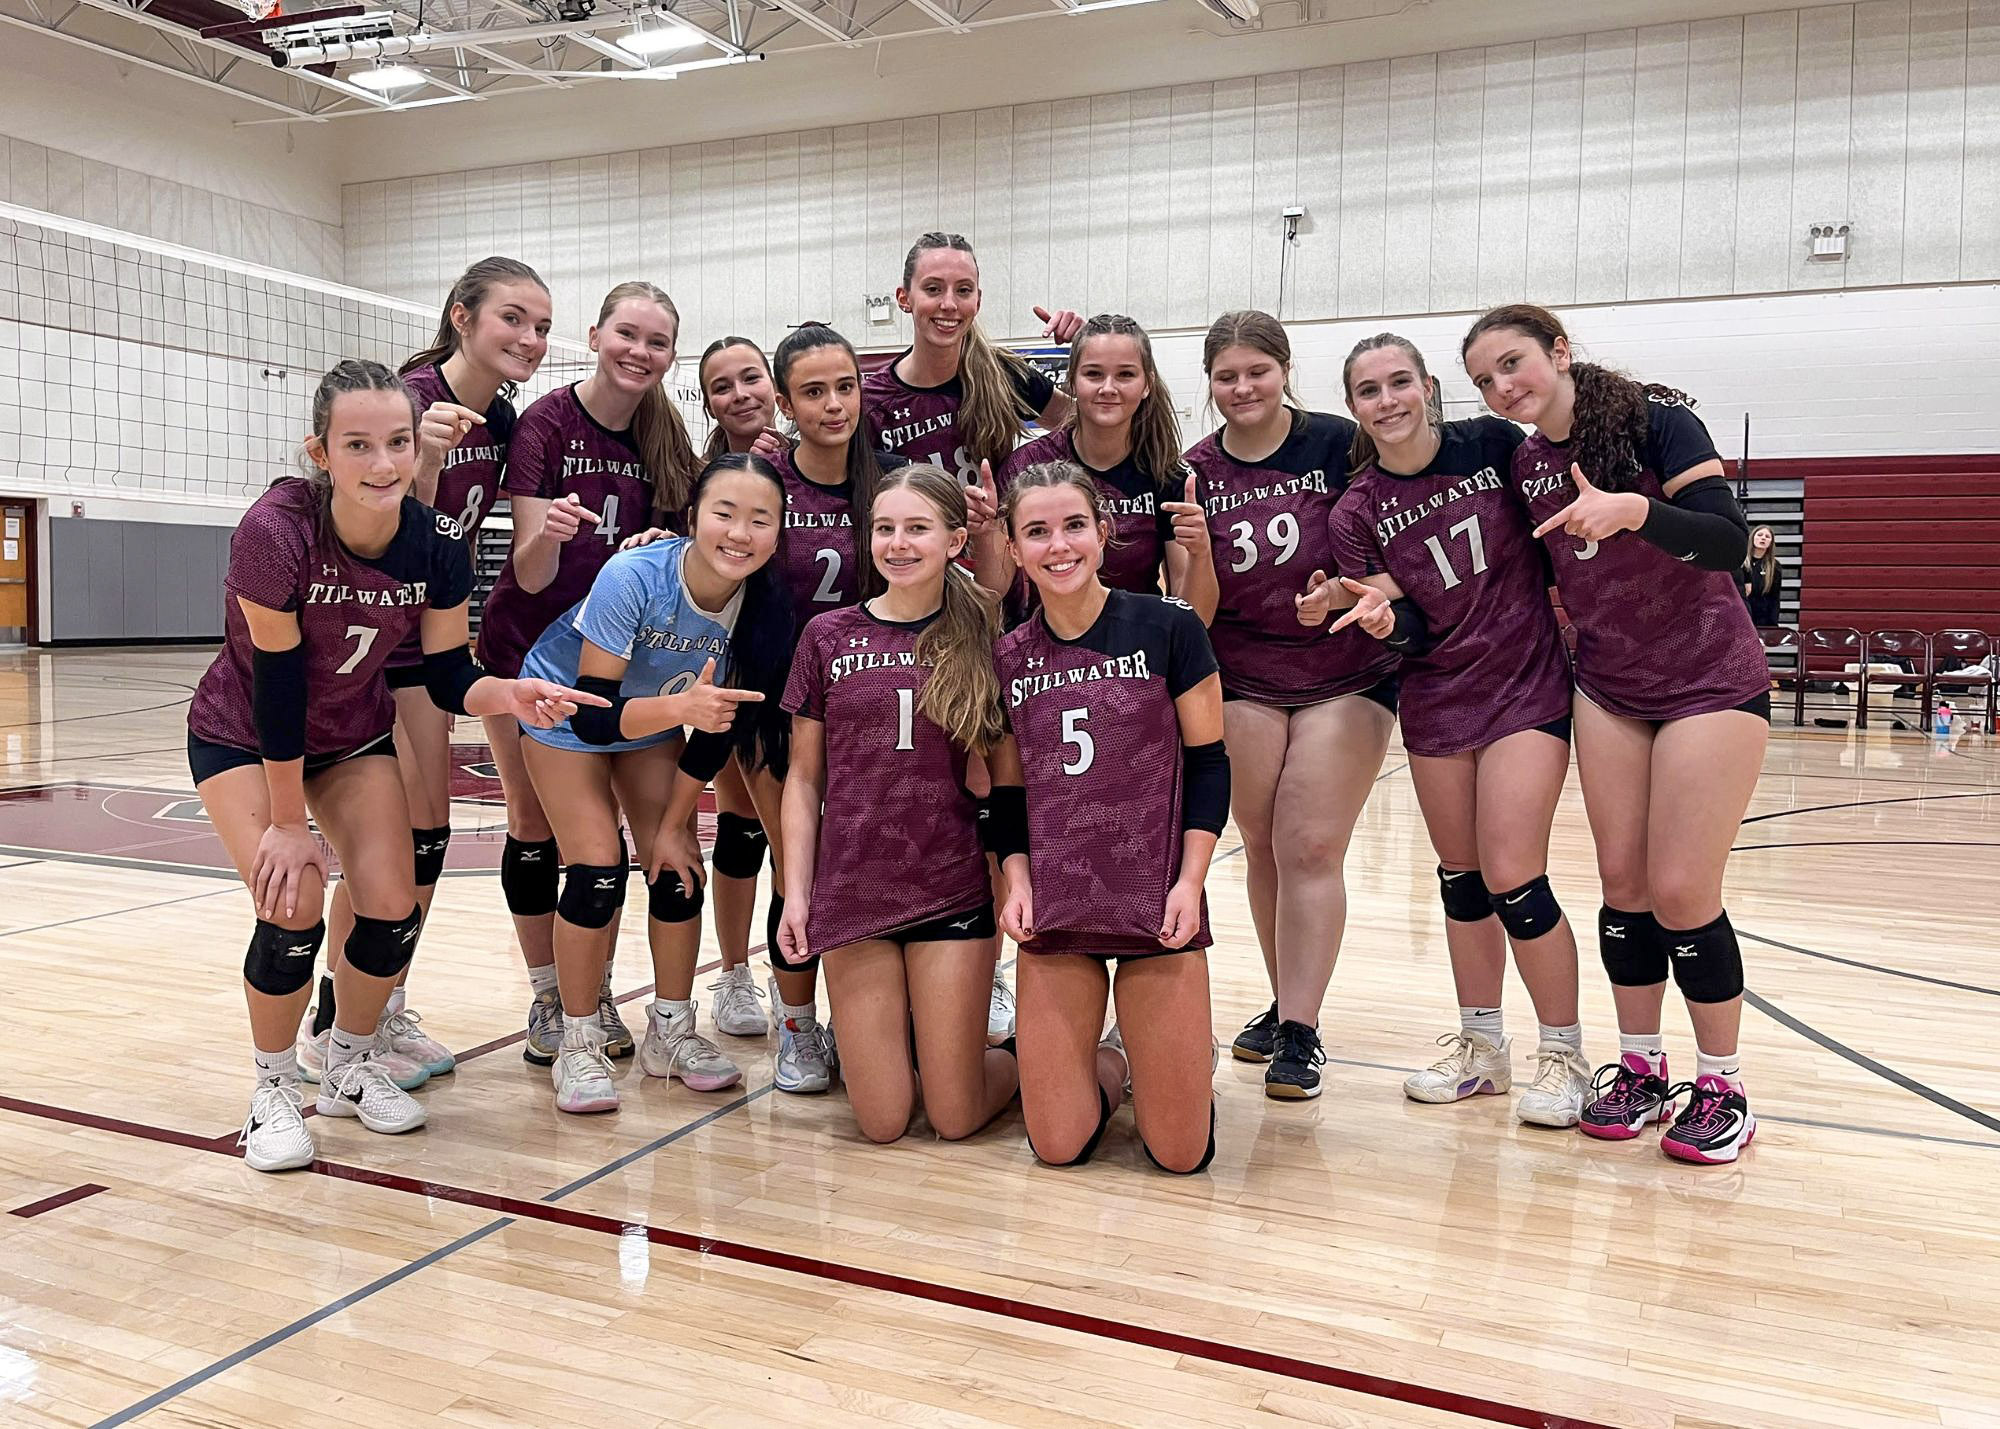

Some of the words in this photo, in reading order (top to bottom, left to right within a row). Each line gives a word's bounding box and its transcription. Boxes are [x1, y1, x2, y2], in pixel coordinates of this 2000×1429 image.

[458, 484, 484, 533] 8
[594, 494, 621, 545] 4
[1376, 466, 1503, 547] STILLWATER
[1229, 512, 1300, 573] 39
[1423, 513, 1488, 591] 17
[305, 582, 428, 606] TILLWATER
[812, 548, 843, 602] 2
[335, 625, 380, 674] 7
[1011, 650, 1150, 708] STILLWATER
[895, 688, 915, 750] 1
[1061, 707, 1095, 776] 5
